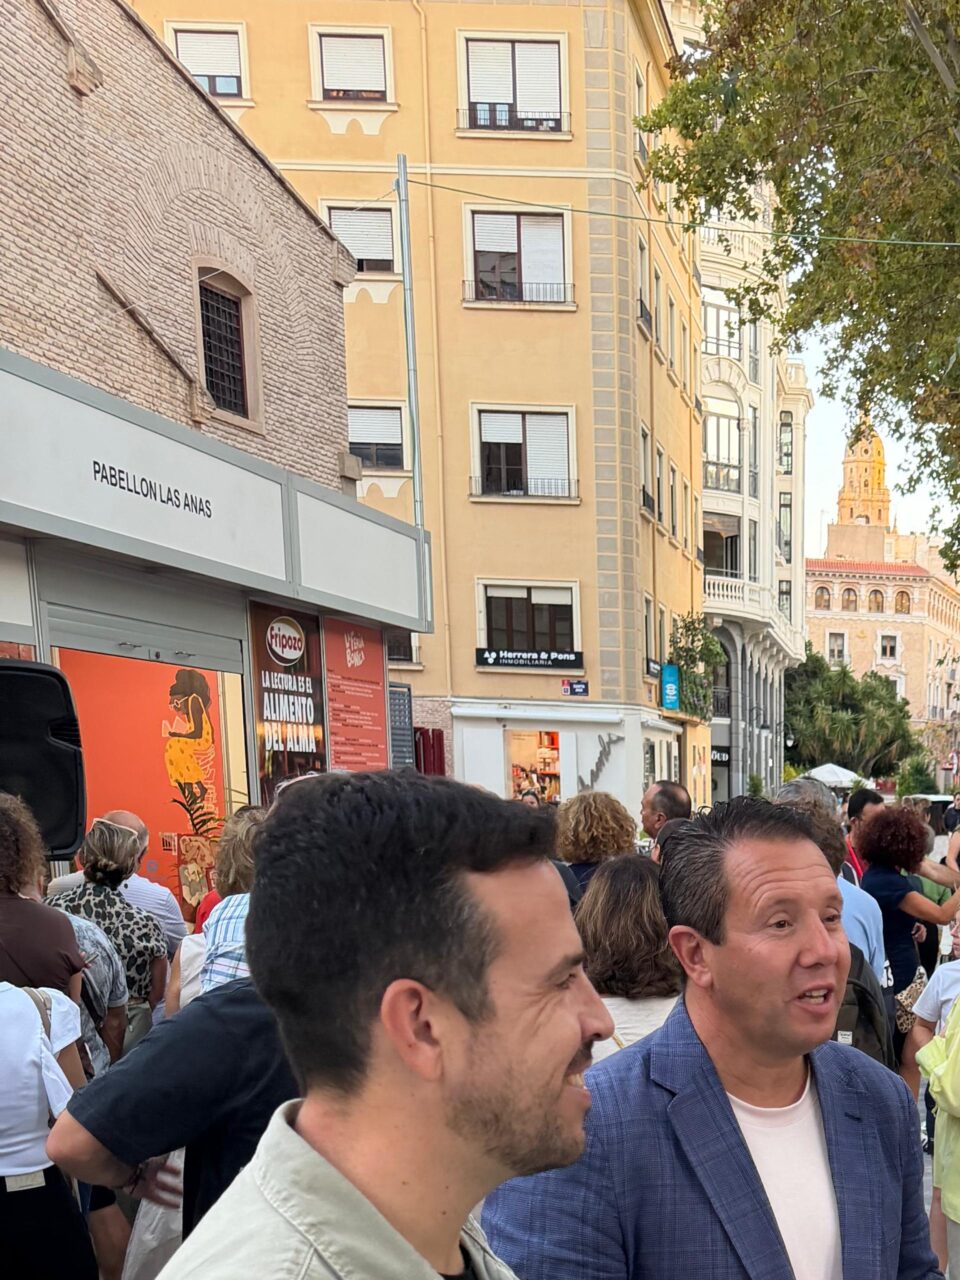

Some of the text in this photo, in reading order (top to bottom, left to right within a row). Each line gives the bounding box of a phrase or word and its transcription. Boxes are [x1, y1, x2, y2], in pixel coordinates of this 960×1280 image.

[93, 460, 212, 518] PABELLON LAS ANAS
[499, 651, 576, 661] Herrera & Pons
[262, 671, 313, 694] LA LECTURA ES EL
[264, 692, 314, 724] ALIMENTO
[265, 722, 317, 753] DEL ALMA
